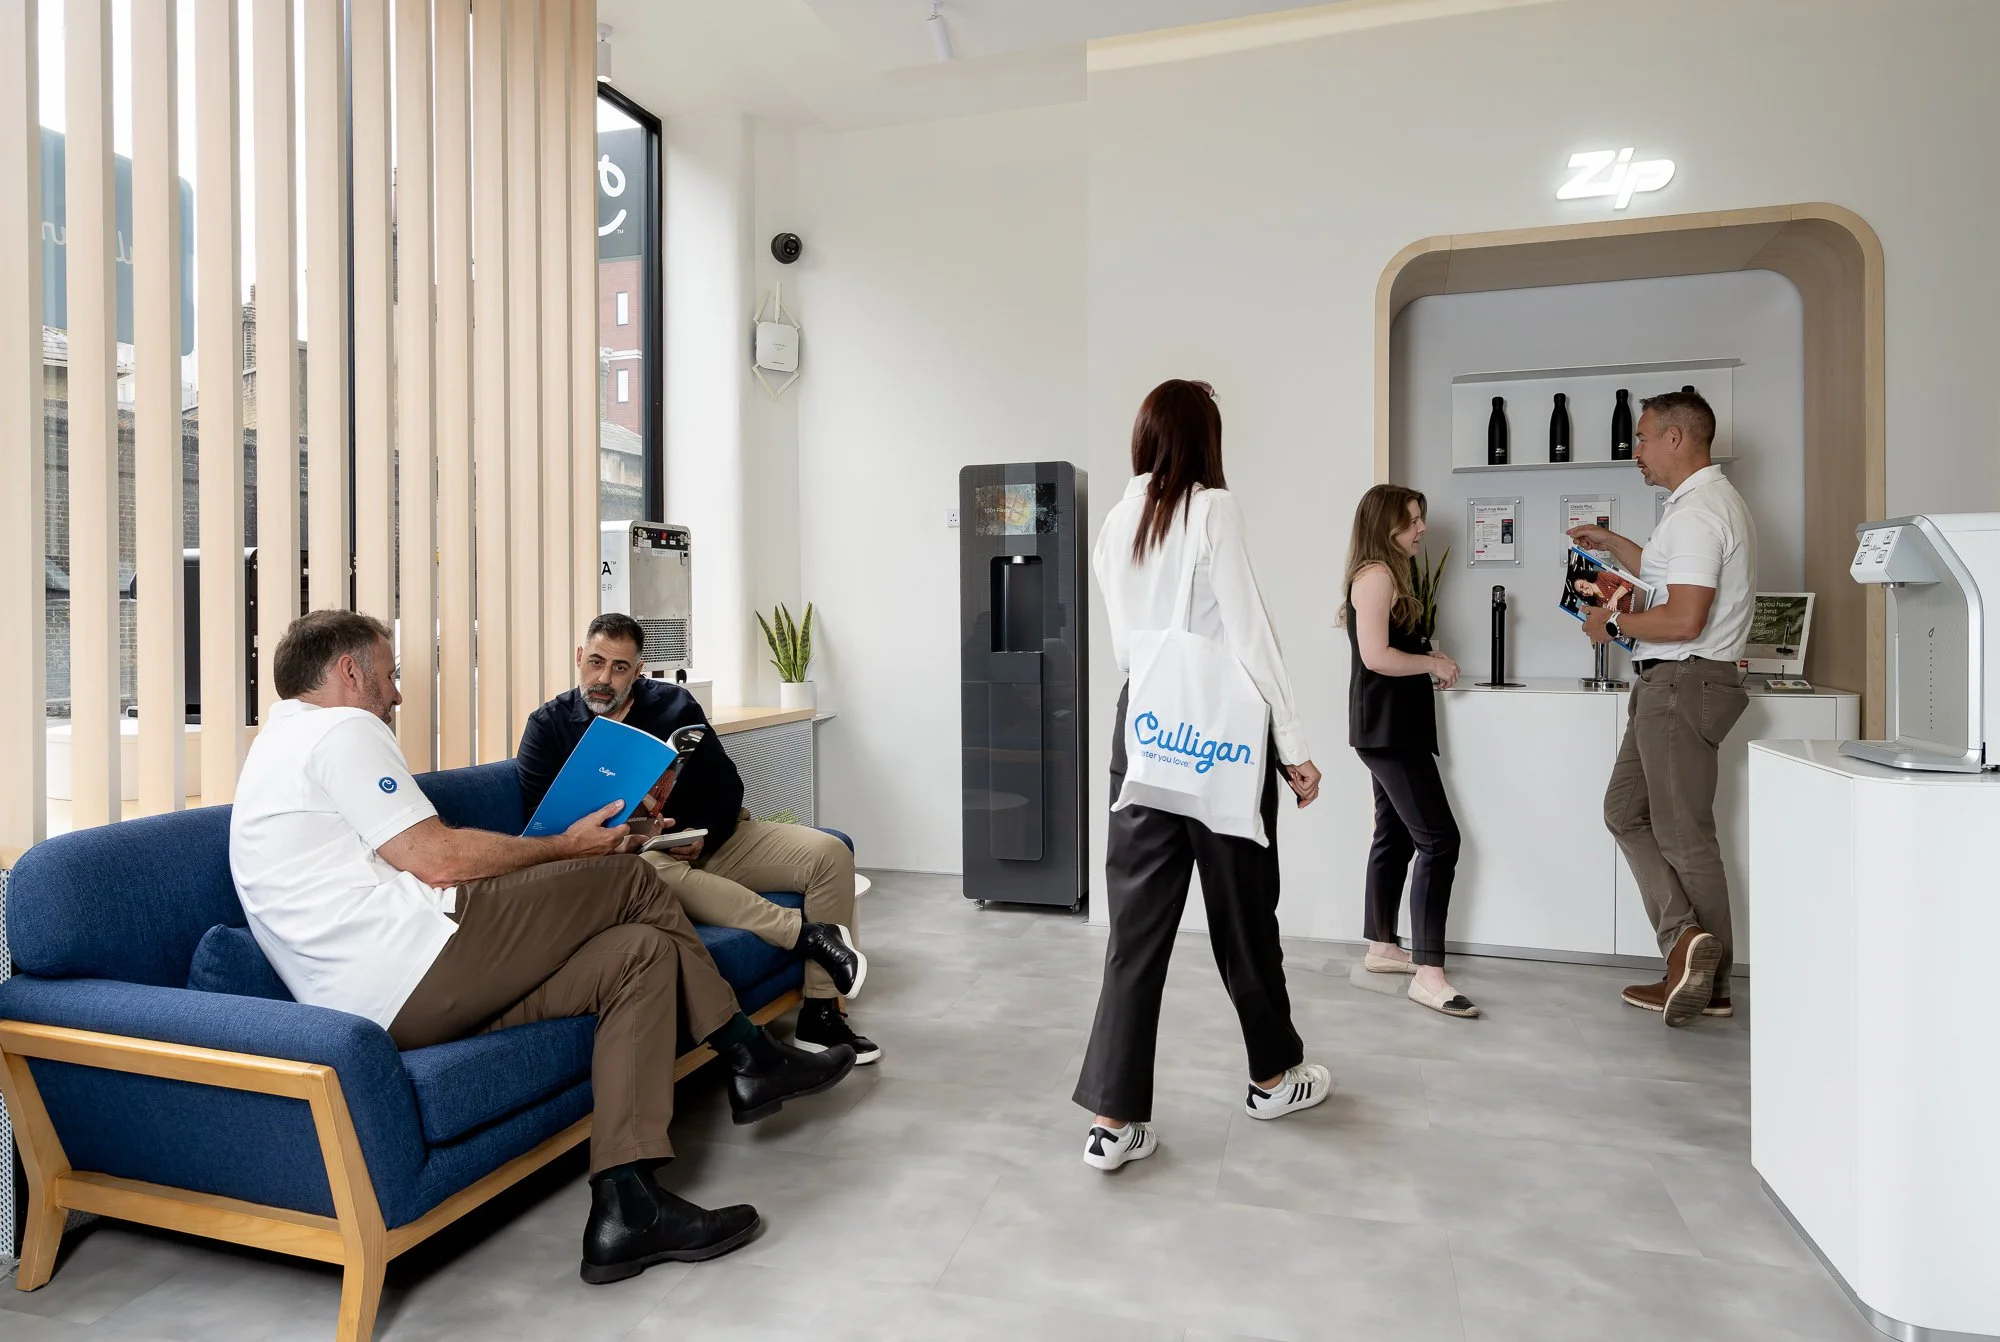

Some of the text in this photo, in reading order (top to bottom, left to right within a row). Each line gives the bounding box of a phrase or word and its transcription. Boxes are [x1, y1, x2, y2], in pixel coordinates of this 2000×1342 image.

[1556, 147, 1676, 211] Zip
[1134, 711, 1251, 774] Culligan
[1142, 750, 1157, 759] ater
